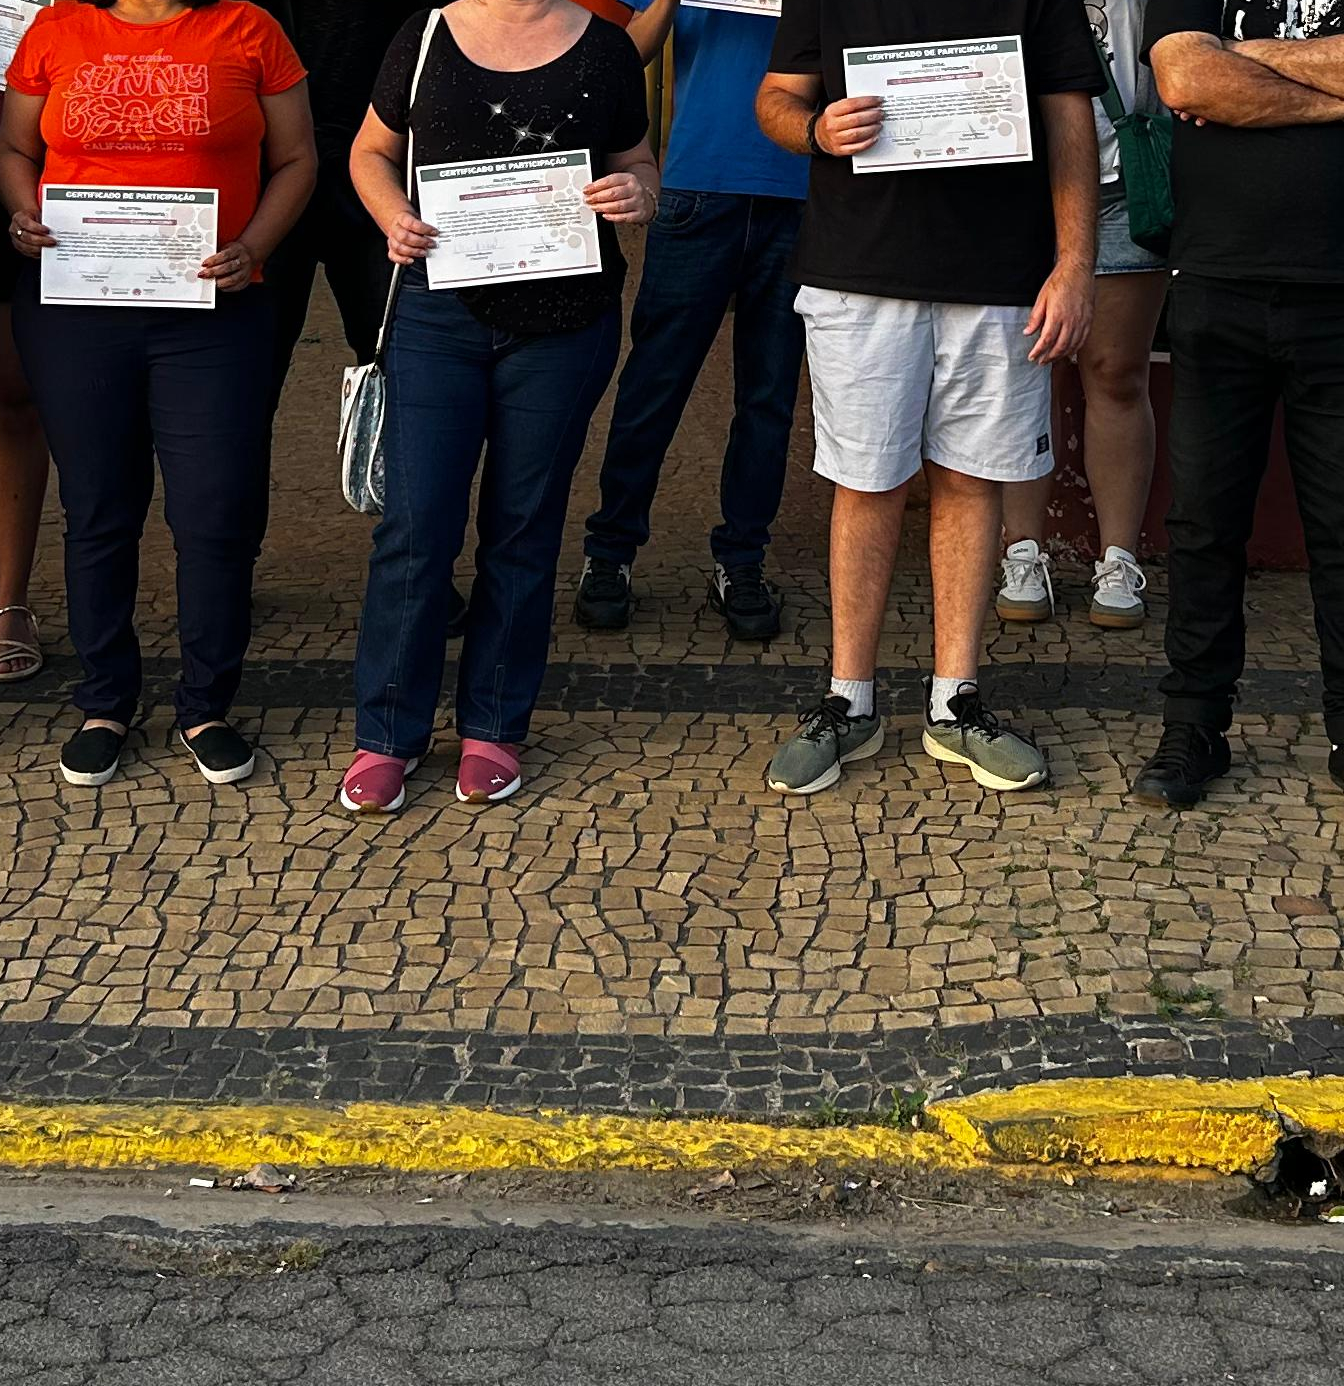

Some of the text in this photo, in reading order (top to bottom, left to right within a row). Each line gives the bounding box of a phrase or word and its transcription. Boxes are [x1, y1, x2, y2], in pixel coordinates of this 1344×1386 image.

[867, 50, 922, 61] CERTIFICADO
[938, 43, 998, 55] PARTICIPAÇÃO
[69, 62, 208, 96] SUNNY
[439, 165, 493, 177] CERTIFICADO
[508, 157, 567, 170] PARTICIPAÇÃO
[66, 191, 120, 199] CERTIFICADO
[136, 193, 195, 202] PARTICIPAÇÃO
